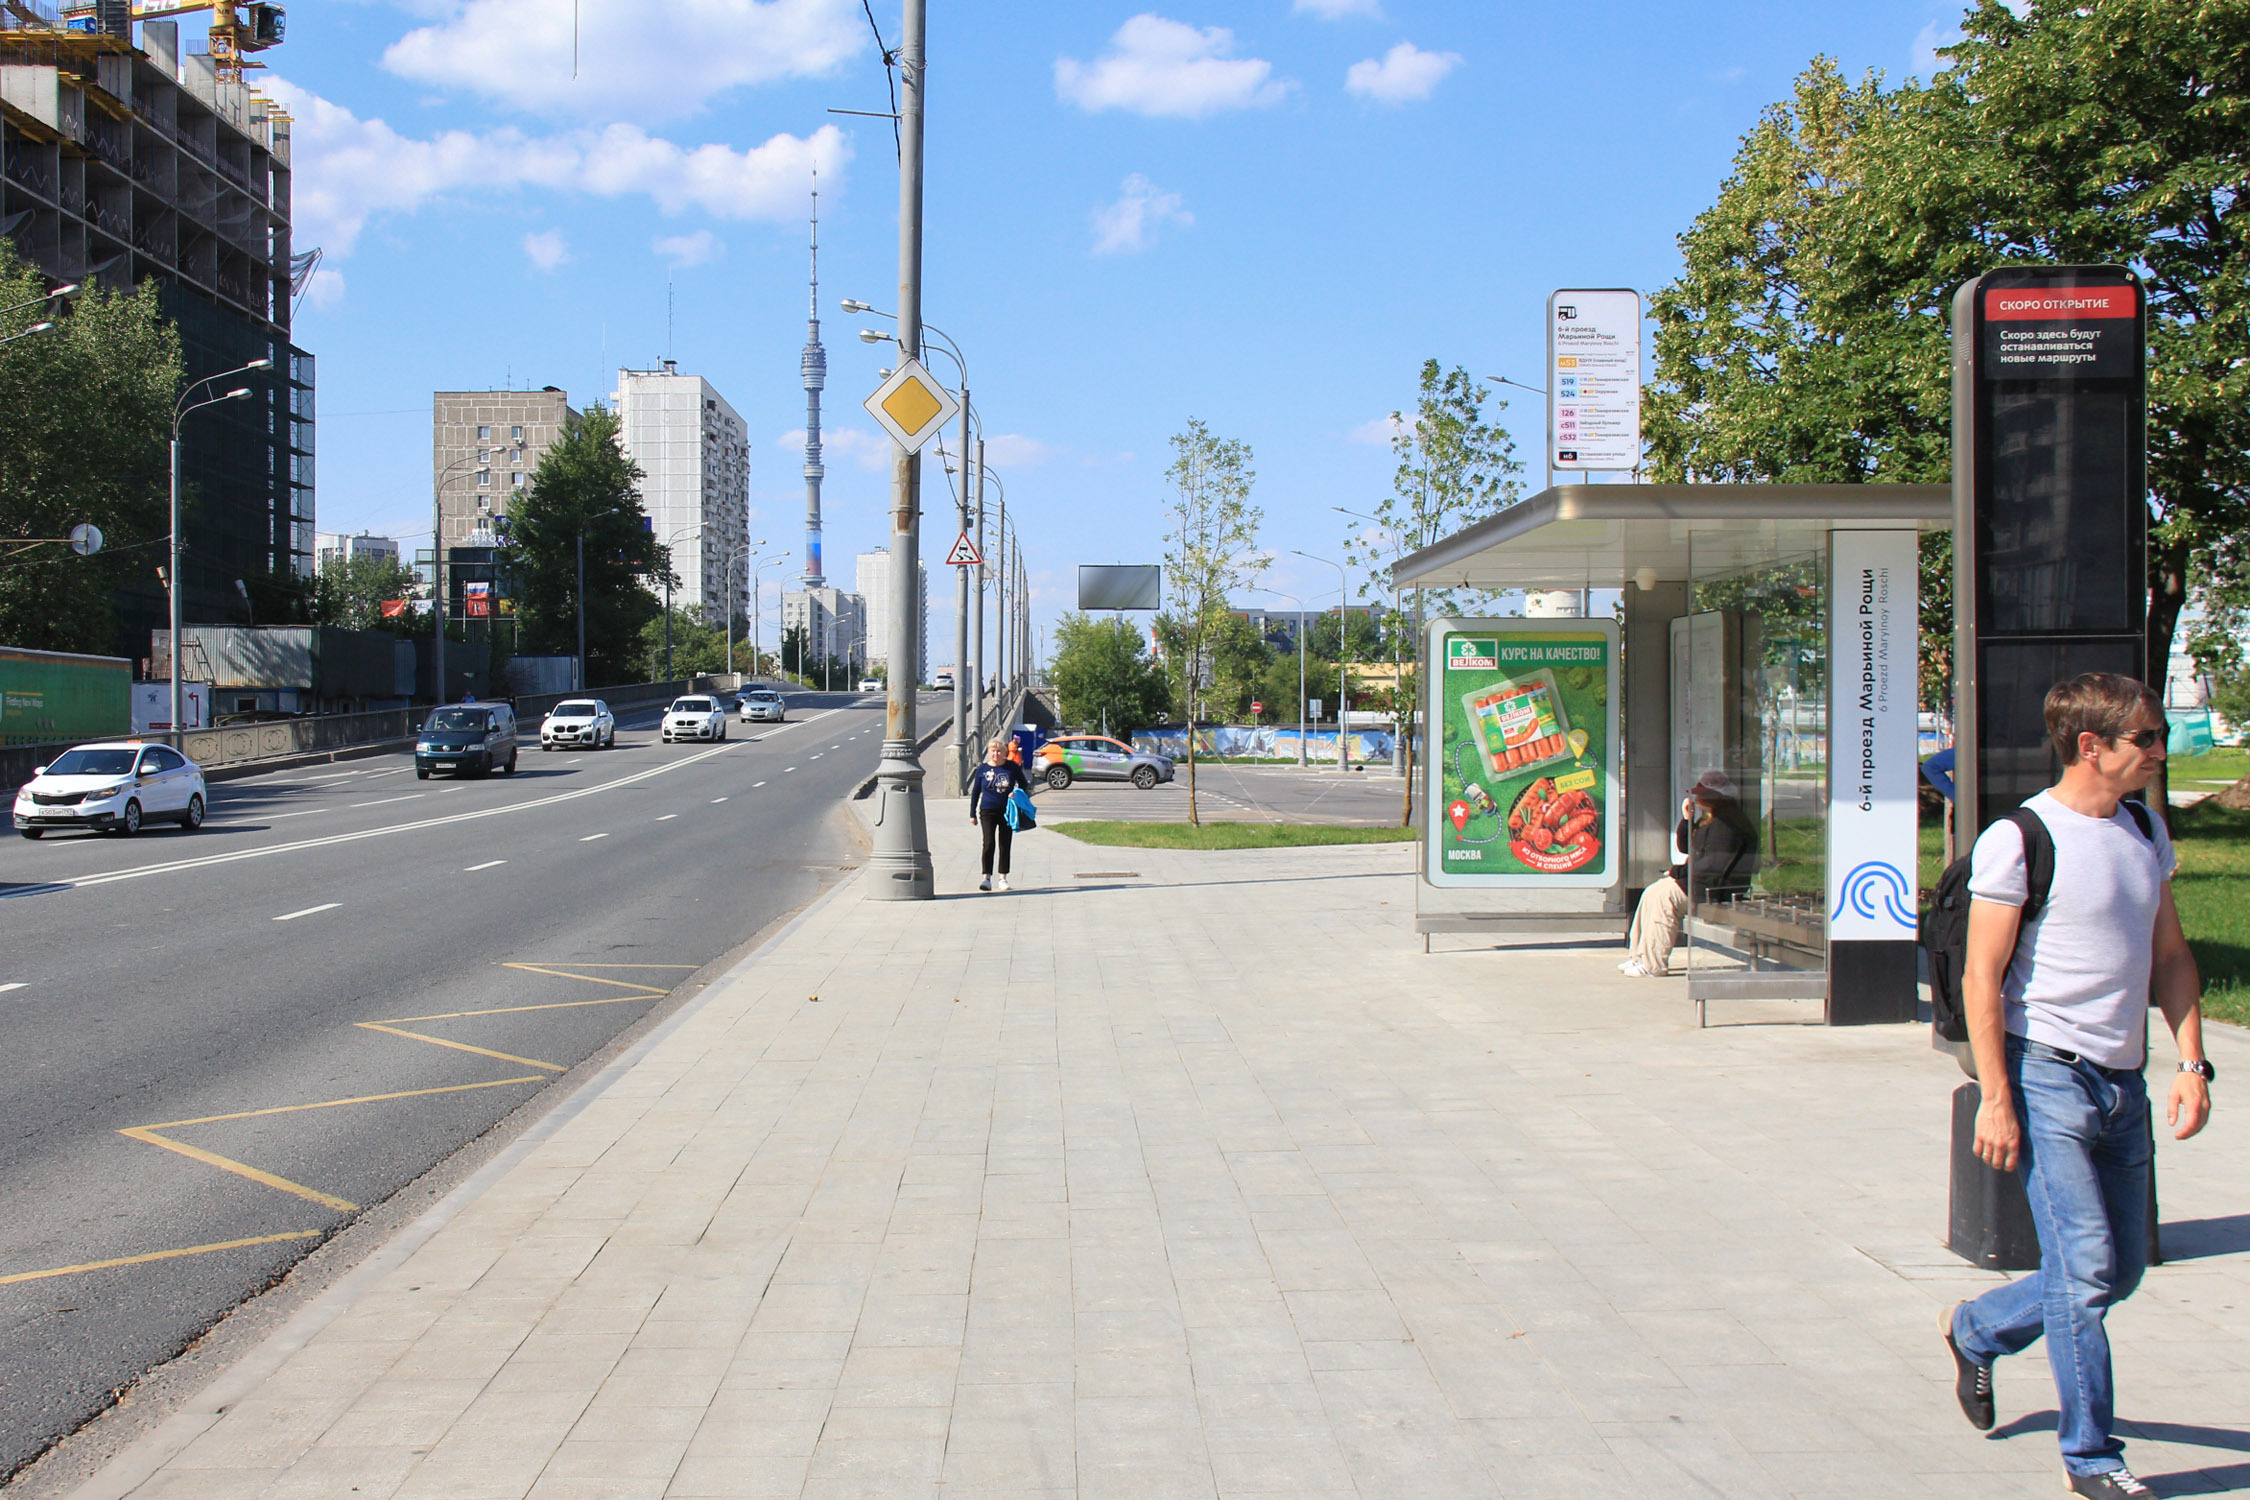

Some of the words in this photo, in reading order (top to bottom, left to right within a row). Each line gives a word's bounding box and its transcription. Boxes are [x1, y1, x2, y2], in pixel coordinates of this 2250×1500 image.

[1999, 300, 2040, 310] СКОРО
[2043, 299, 2109, 310] ОТКРЫТИЕ
[2000, 330, 2034, 341] Скоро
[2036, 331, 2068, 340] здесь
[2070, 329, 2101, 340] будут
[2000, 342, 2093, 351] останавливаться
[2000, 355, 2035, 363] новые
[2038, 354, 2096, 364] маршруты
[1859, 568, 1875, 615] Рощи
[1878, 567, 1889, 604] Roschi
[1878, 608, 1891, 660] Maryinoy
[1501, 648, 1528, 660] КУРС
[1530, 648, 1544, 660] НА
[1546, 648, 1600, 660] КАЧЕСТВО!
[1859, 621, 1876, 711] Марьиной
[1878, 664, 1888, 702] Proezd
[1878, 705, 1888, 713] 6
[1861, 717, 1876, 779] проезд
[1859, 784, 1873, 812] 6-й
[1448, 849, 1482, 860] МОСКВА
[1522, 846, 1531, 855] ИЗ
[1530, 852, 1570, 863] ОТБОРНОГО
[1543, 861, 1573, 869] СПЕЦИЙ
